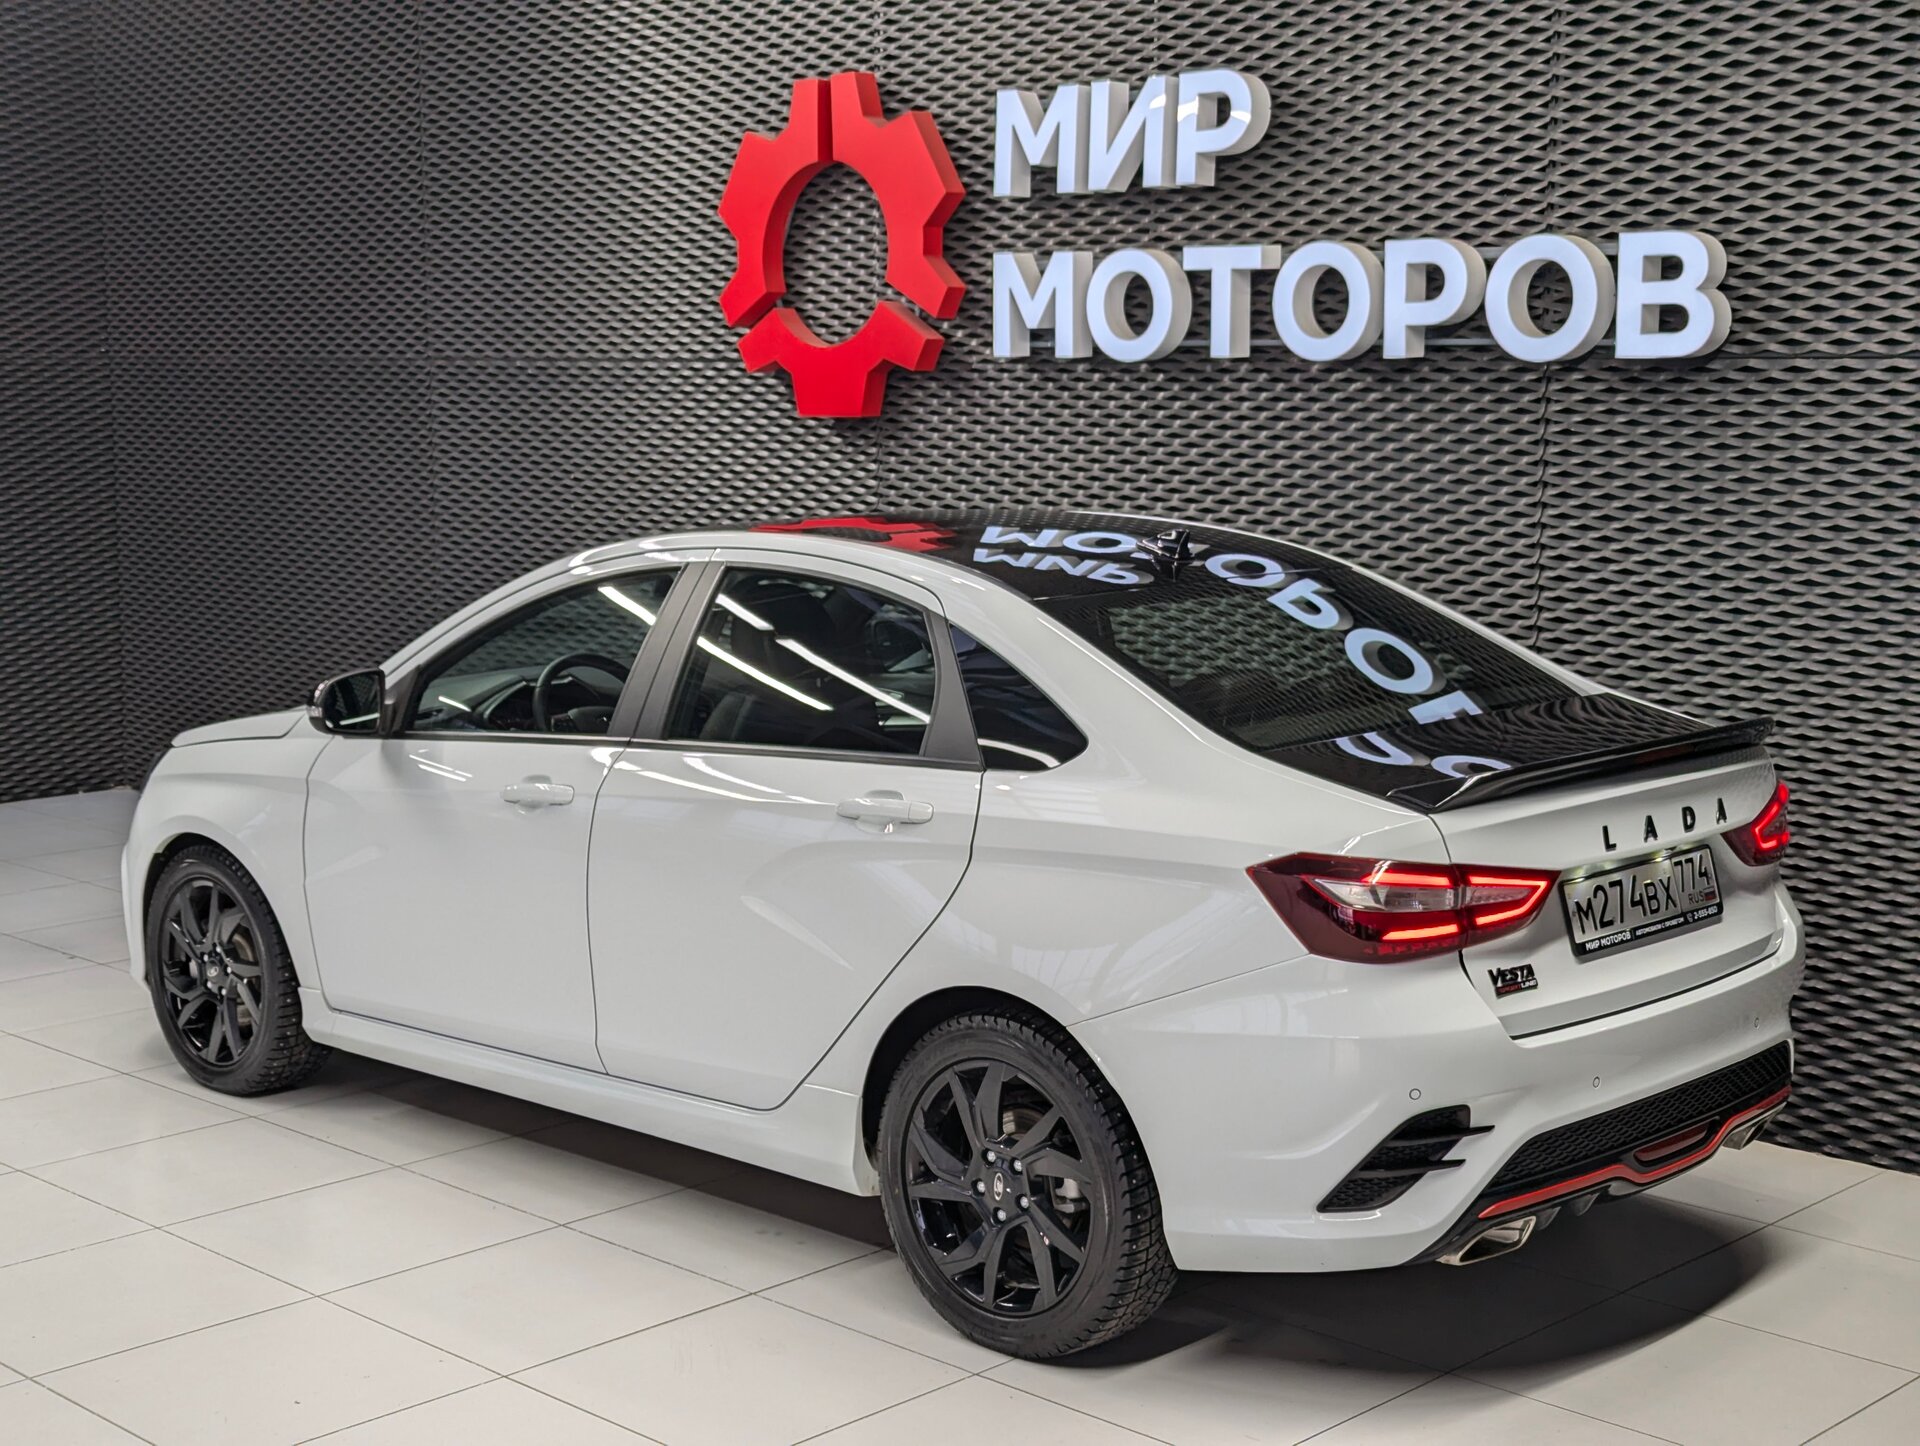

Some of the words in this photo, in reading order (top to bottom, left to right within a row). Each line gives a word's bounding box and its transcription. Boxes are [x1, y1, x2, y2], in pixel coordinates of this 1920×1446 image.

[993, 69, 1271, 197] МИР
[993, 231, 1732, 363] МОТОРОВ
[1602, 798, 1728, 852] LADA
[1674, 854, 1711, 893] 774
[1688, 890, 1706, 905] RUS
[1585, 940, 1600, 951] МИР
[1601, 931, 1631, 947] МОТОРОВ
[1487, 964, 1535, 988] VESTA
